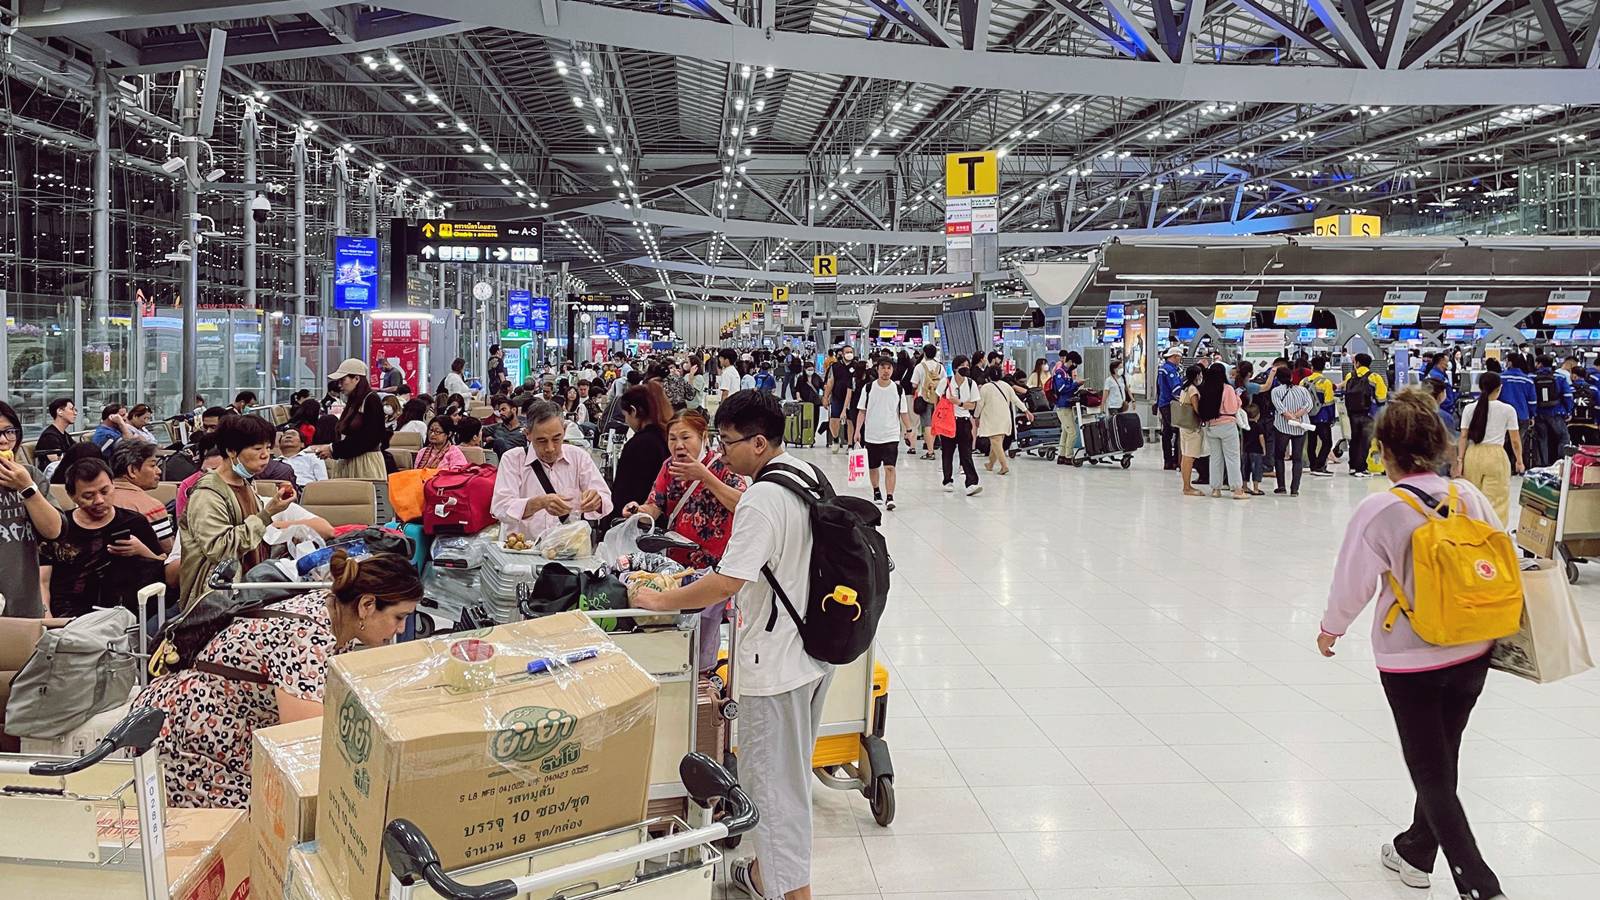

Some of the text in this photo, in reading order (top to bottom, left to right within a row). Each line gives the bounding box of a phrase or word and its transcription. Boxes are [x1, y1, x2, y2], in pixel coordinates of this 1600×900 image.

[958, 156, 985, 191] T
[521, 228, 538, 236] A-S
[818, 257, 832, 275] R
[776, 288, 785, 300] P
[754, 303, 763, 312] M
[742, 312, 748, 320] K
[382, 320, 411, 330] SNACK
[382, 329, 411, 337] &DRINK
[491, 710, 578, 761] ยำยำ
[507, 783, 556, 805] รสหมูสับ
[463, 817, 505, 838] บรรจุ
[512, 809, 530, 824] 10
[464, 840, 504, 858] จำนวน
[512, 833, 527, 846] 18
